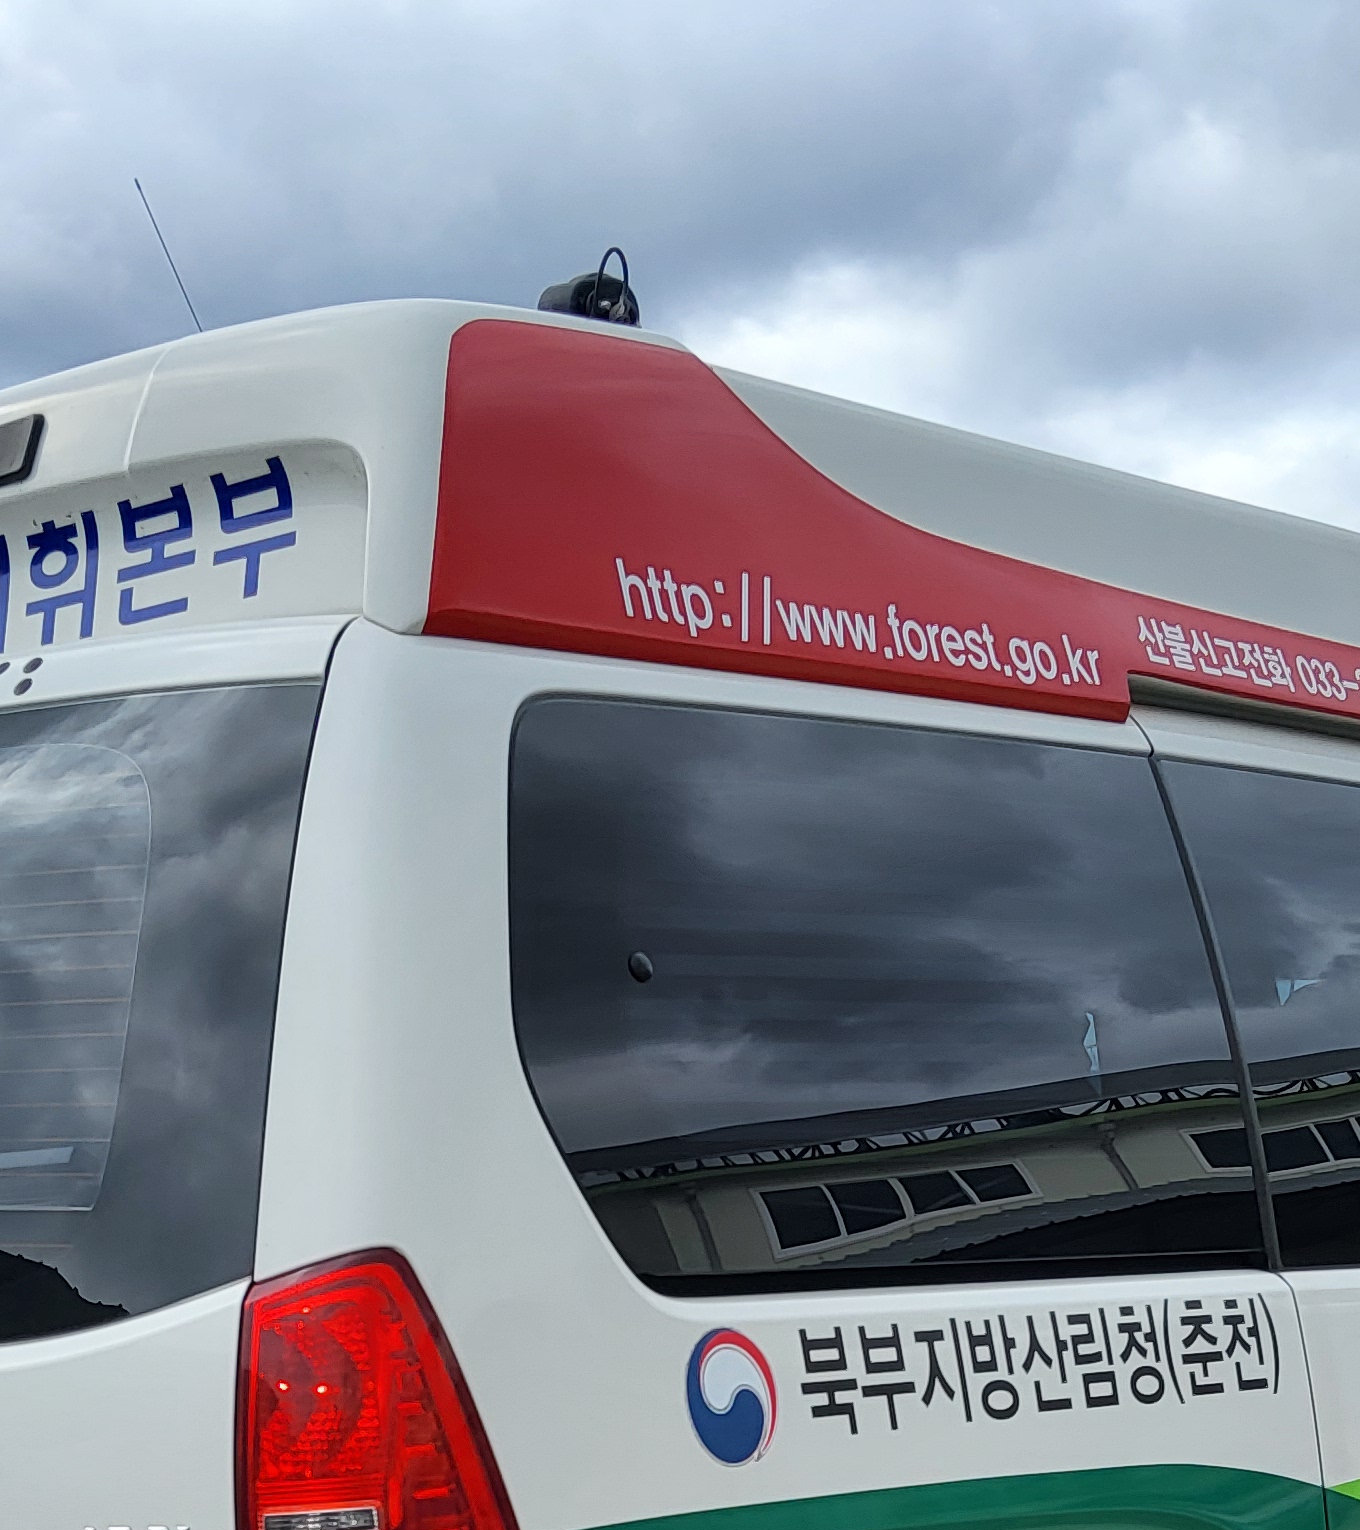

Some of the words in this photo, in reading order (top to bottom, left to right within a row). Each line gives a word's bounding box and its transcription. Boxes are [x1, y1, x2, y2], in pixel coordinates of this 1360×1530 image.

[614, 556, 1104, 687] http://www.forest.go.kr
[1136, 614, 1298, 693] 산불신고전화
[797, 1292, 1281, 1435] 북부지방산림청(춘천)
